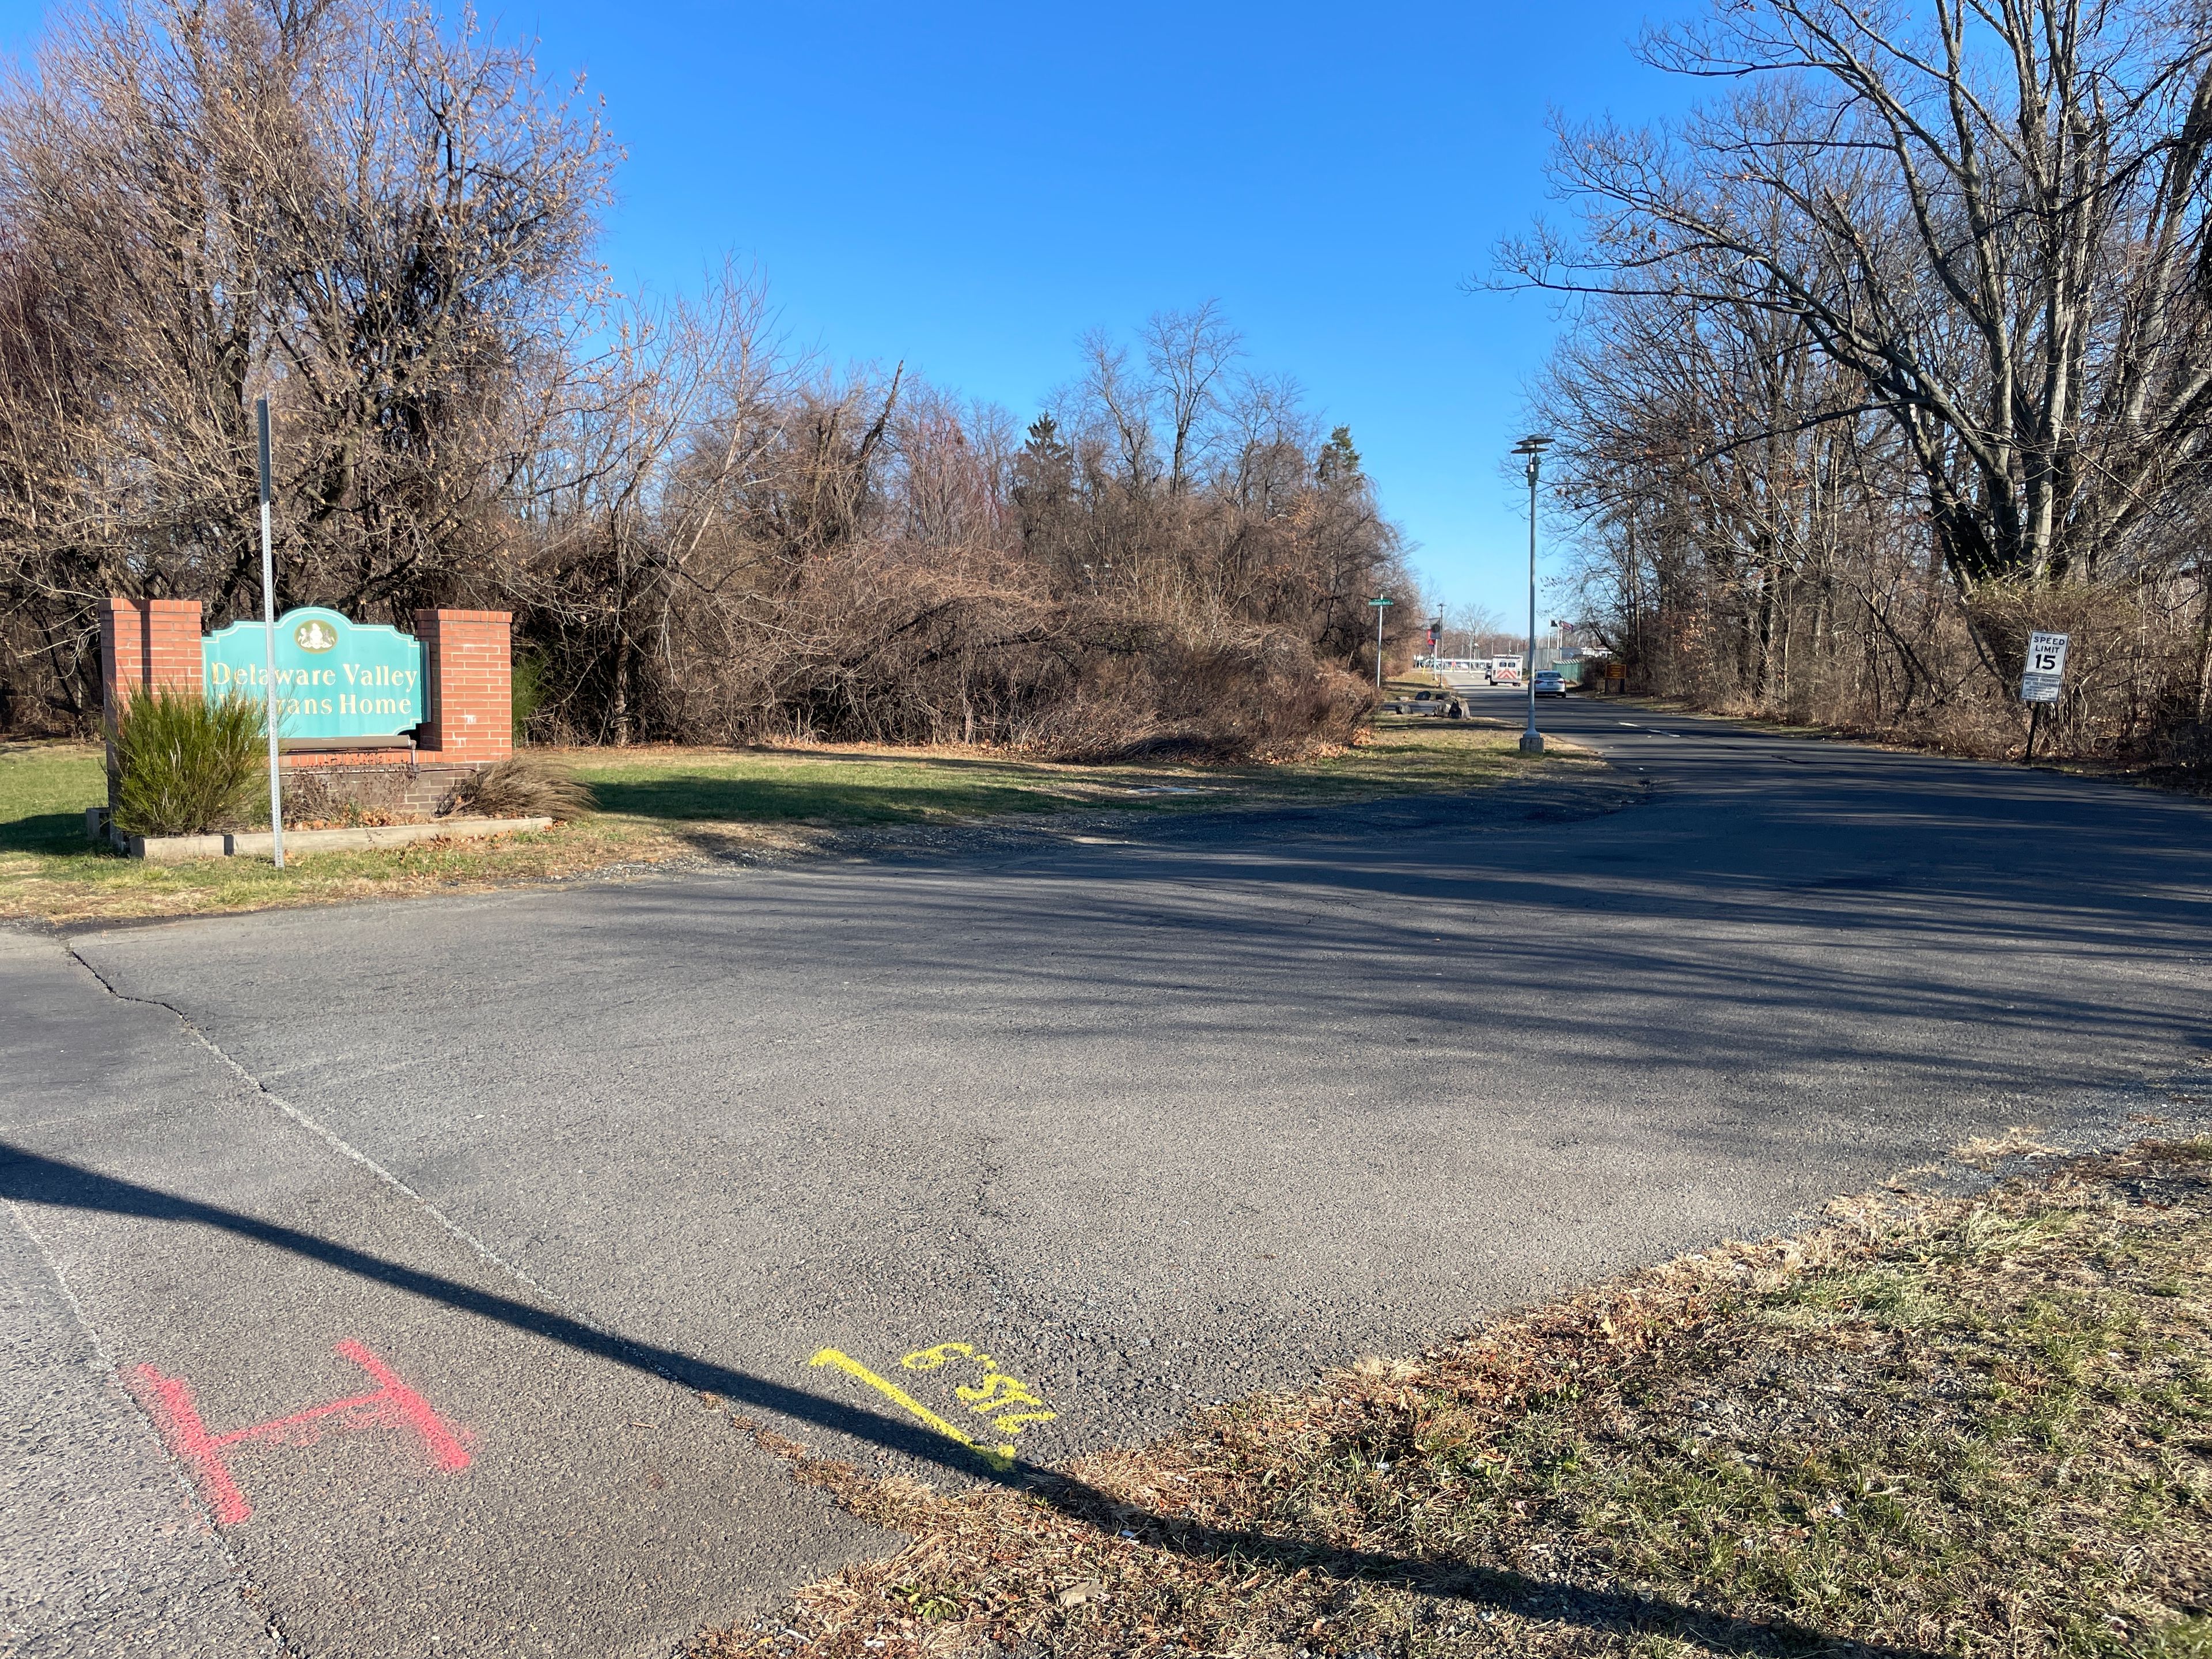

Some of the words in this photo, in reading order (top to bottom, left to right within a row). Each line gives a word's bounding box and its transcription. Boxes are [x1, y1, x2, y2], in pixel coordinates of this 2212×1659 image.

[2034, 636, 2065, 646] SPEED
[2035, 645, 2060, 653] LIMIT
[2035, 654, 2056, 670] 15
[211, 662, 336, 685] Delaware
[343, 664, 418, 692] Valley
[339, 694, 411, 714] Home
